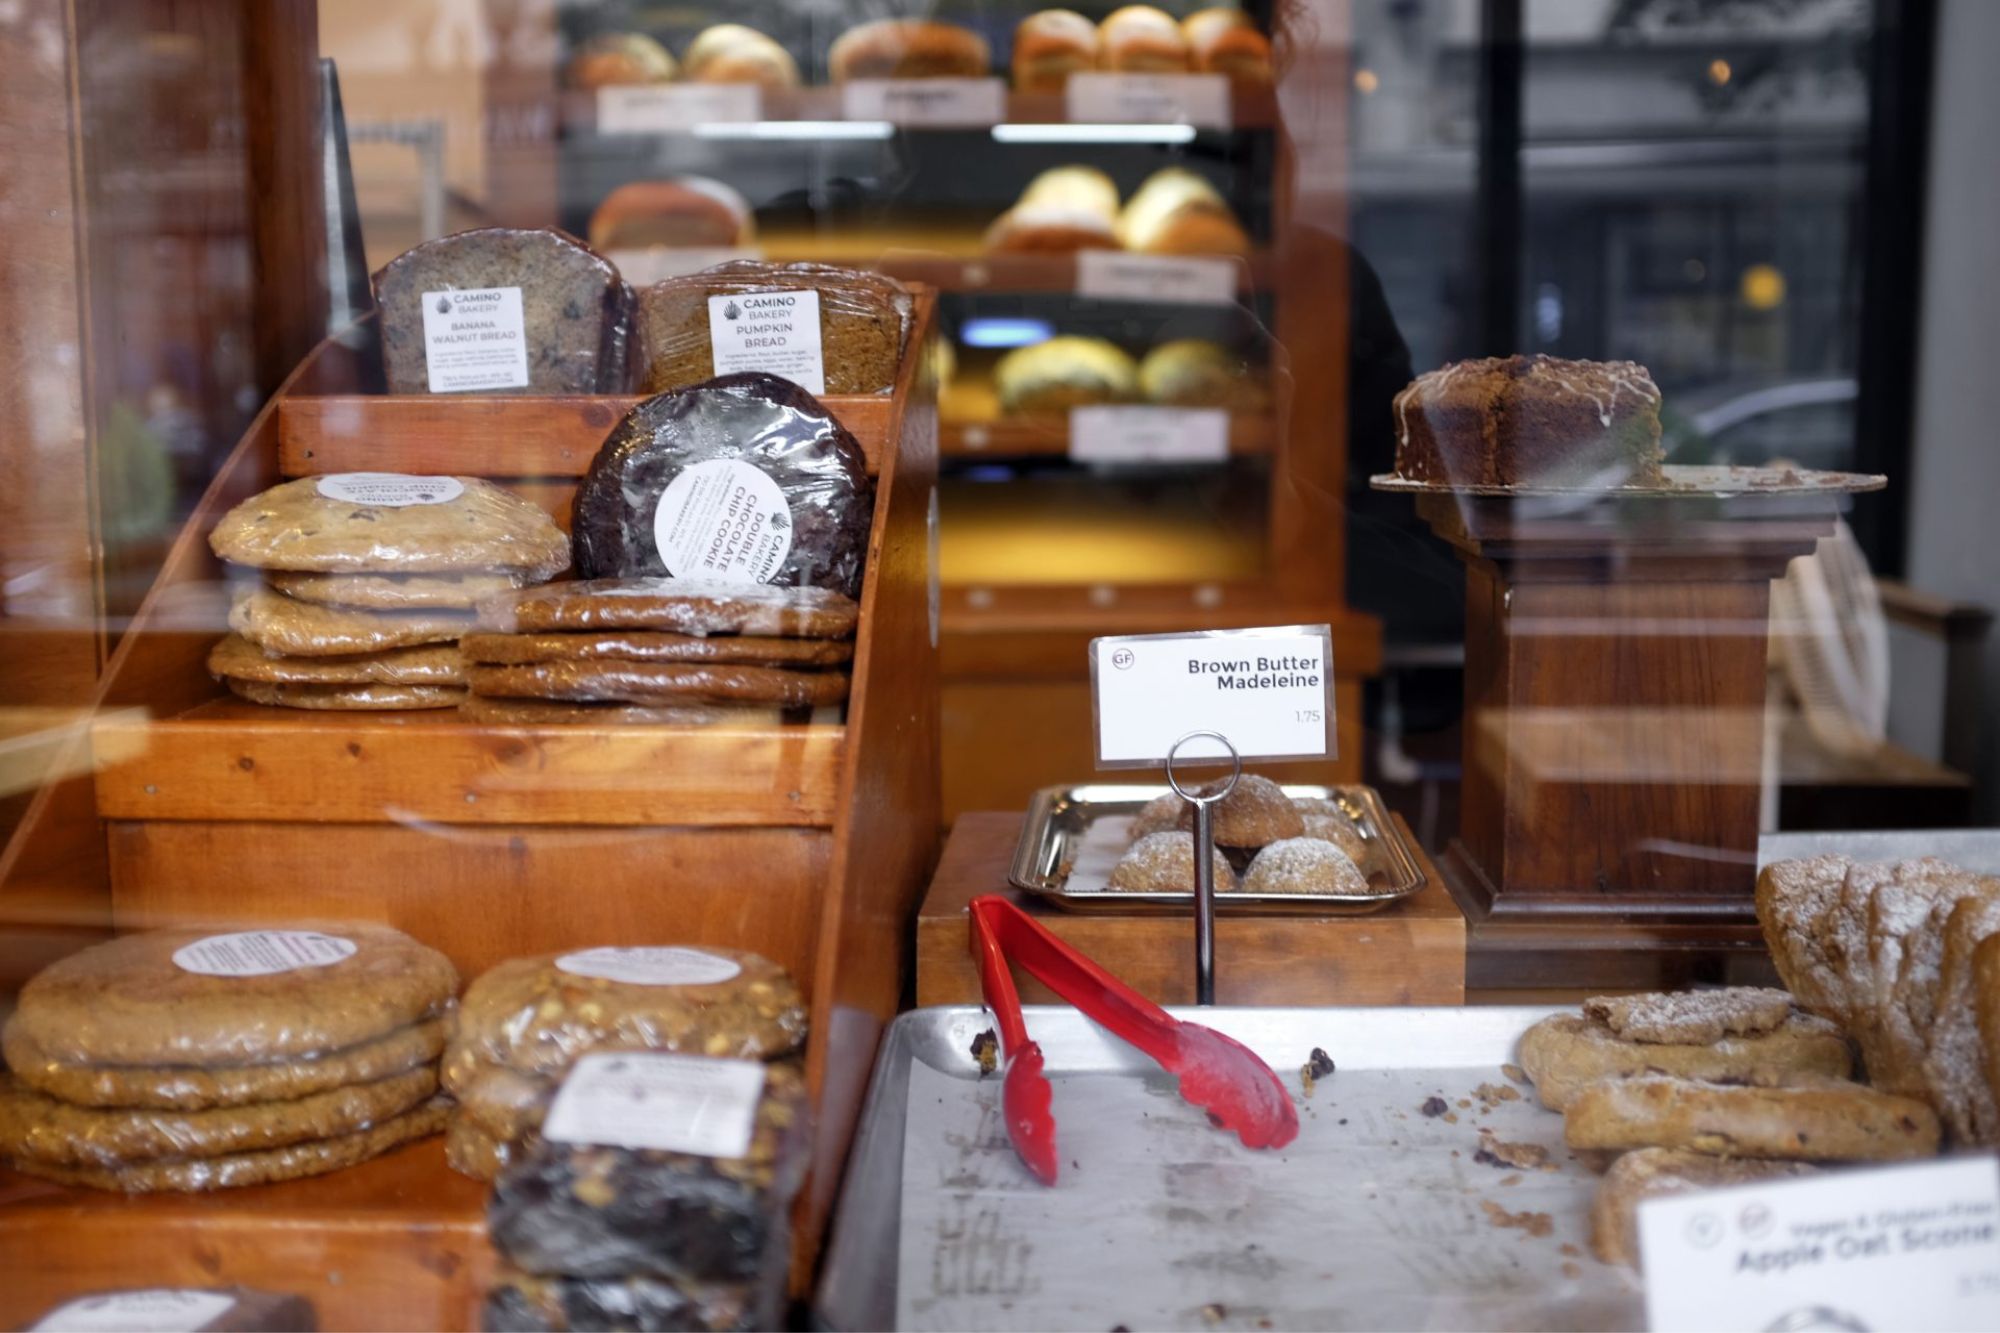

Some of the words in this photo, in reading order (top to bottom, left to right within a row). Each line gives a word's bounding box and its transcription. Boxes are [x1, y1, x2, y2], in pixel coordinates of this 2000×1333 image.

[453, 292, 502, 304] CAMINO
[743, 296, 796, 309] CAMINO
[458, 304, 499, 314] BAKERY
[748, 309, 793, 321] BAKERY
[451, 321, 496, 331] BANANA
[736, 323, 793, 335] PUMPKIN
[432, 333, 479, 344] WALNUT
[479, 331, 517, 341] BREAD
[744, 337, 787, 349] BREAD
[728, 486, 746, 518] CHIP
[717, 494, 758, 573] CHOCOLATE
[735, 512, 765, 566] DOUBLE
[703, 519, 732, 569] COOKIE
[748, 534, 771, 577] BAKERY
[756, 535, 784, 585] CAMINO
[1113, 653, 1132, 665] GF
[1188, 659, 1250, 674] Brown
[1257, 656, 1319, 671] Butter
[1217, 673, 1319, 690] Madeleine
[1736, 1242, 1824, 1273] Apple
[1834, 1233, 1890, 1260] Oat
[1901, 1222, 1994, 1251] Scone
